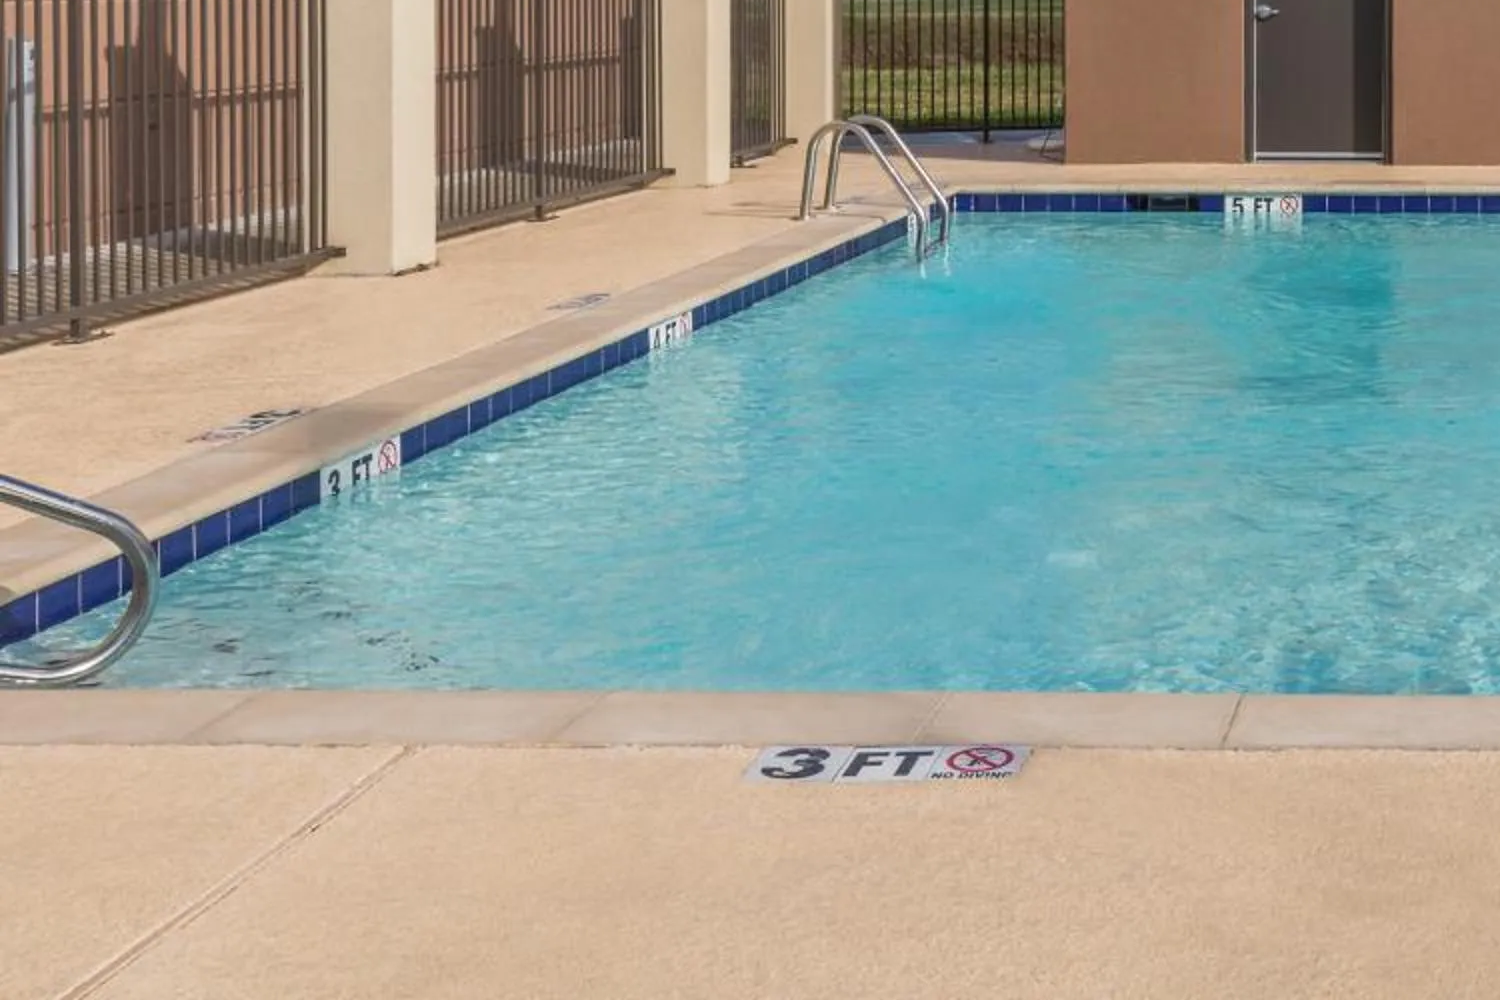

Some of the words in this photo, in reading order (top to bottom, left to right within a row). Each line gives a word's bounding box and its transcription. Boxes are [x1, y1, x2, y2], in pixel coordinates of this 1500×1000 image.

[1231, 197, 1245, 213] 5
[1253, 197, 1275, 213] FT
[327, 468, 341, 497] 3
[352, 453, 373, 487] FT
[760, 747, 831, 779] 3
[842, 750, 934, 778] FT
[931, 771, 954, 779] NO
